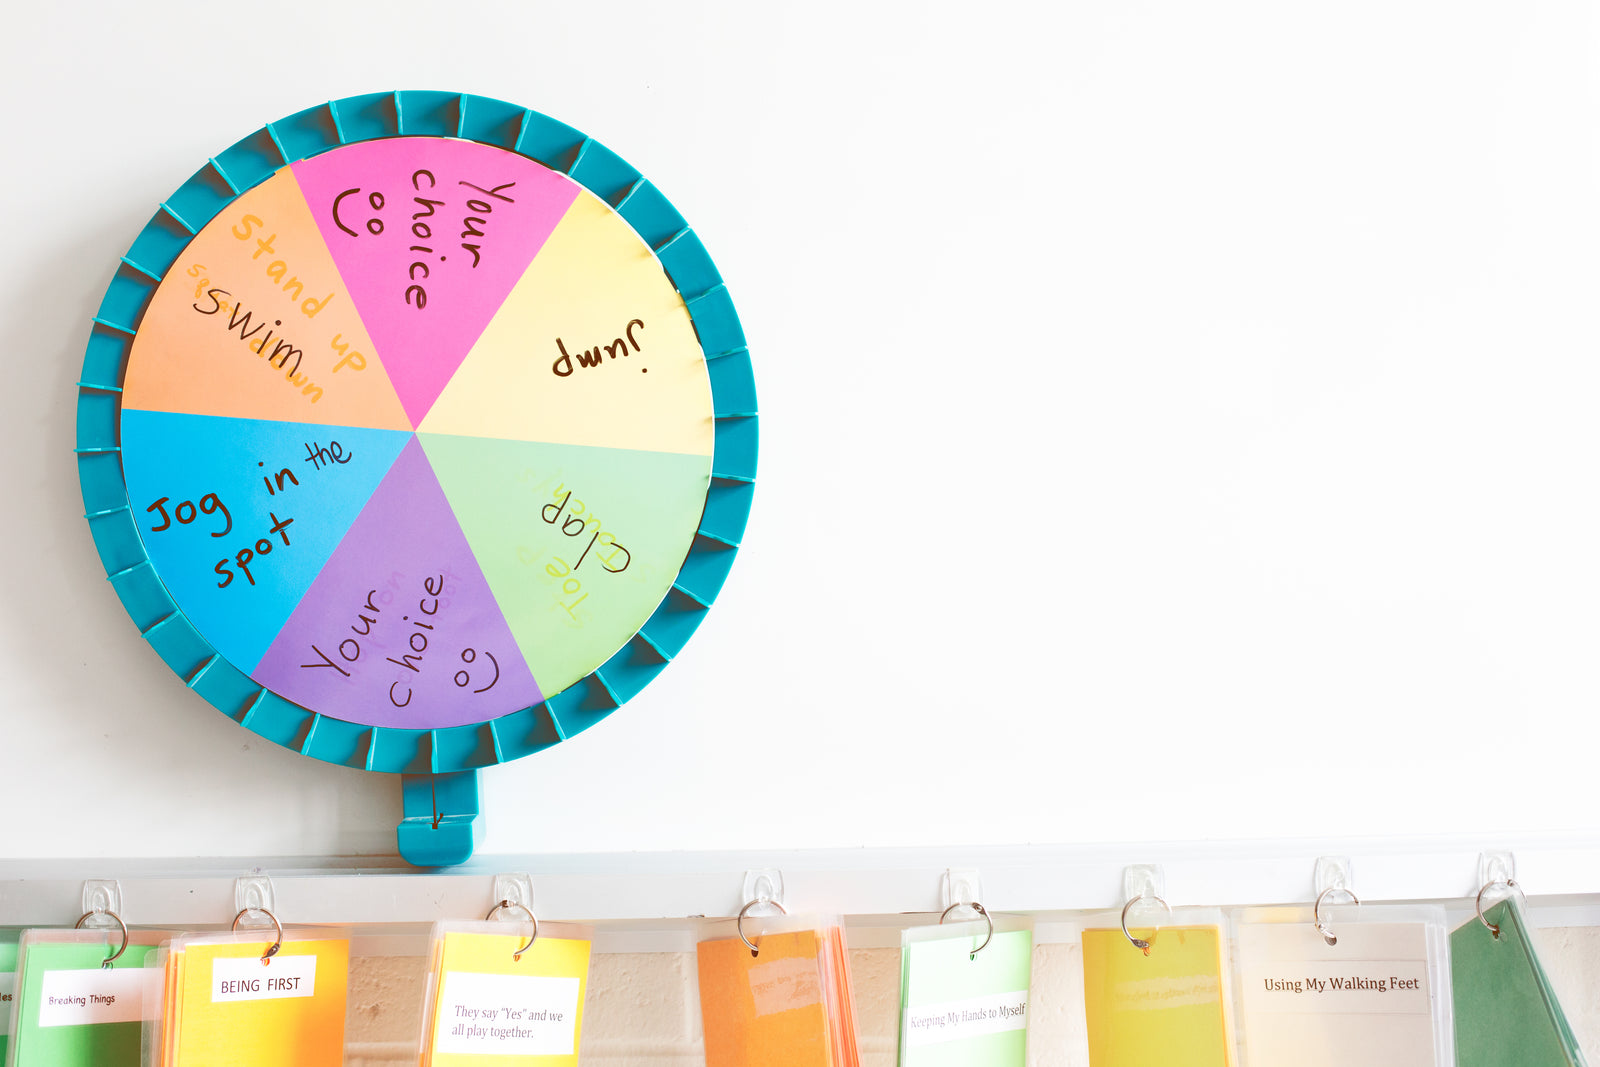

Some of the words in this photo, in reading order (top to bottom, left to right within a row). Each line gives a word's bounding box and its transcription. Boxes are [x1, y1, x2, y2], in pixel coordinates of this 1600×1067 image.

[405, 169, 446, 310] choice
[458, 181, 516, 268] Your
[552, 319, 648, 377] jump
[147, 493, 232, 537] Jog
[258, 461, 299, 496] in
[304, 441, 352, 471] the
[214, 512, 294, 588] spot
[301, 590, 380, 677] Your
[48, 996, 86, 1007] Breaking
[90, 994, 116, 1006] Things
[221, 979, 260, 994] BEING
[267, 977, 301, 991] FIRST
[1264, 978, 1303, 993] Using
[1305, 977, 1326, 992] My
[1329, 976, 1387, 992] Walking
[1389, 977, 1420, 990] Feet
[451, 1023, 465, 1036] all
[467, 1023, 489, 1040] play
[490, 1025, 534, 1041] together.
[455, 1005, 480, 1021] They
[481, 1009, 499, 1022] say
[528, 1009, 547, 1021] and
[549, 1012, 564, 1022] we
[911, 1015, 946, 1030] Keeping
[947, 1011, 960, 1027] My
[962, 1007, 987, 1023] Hands
[989, 1009, 998, 1020] to
[999, 1002, 1026, 1019] Myself
